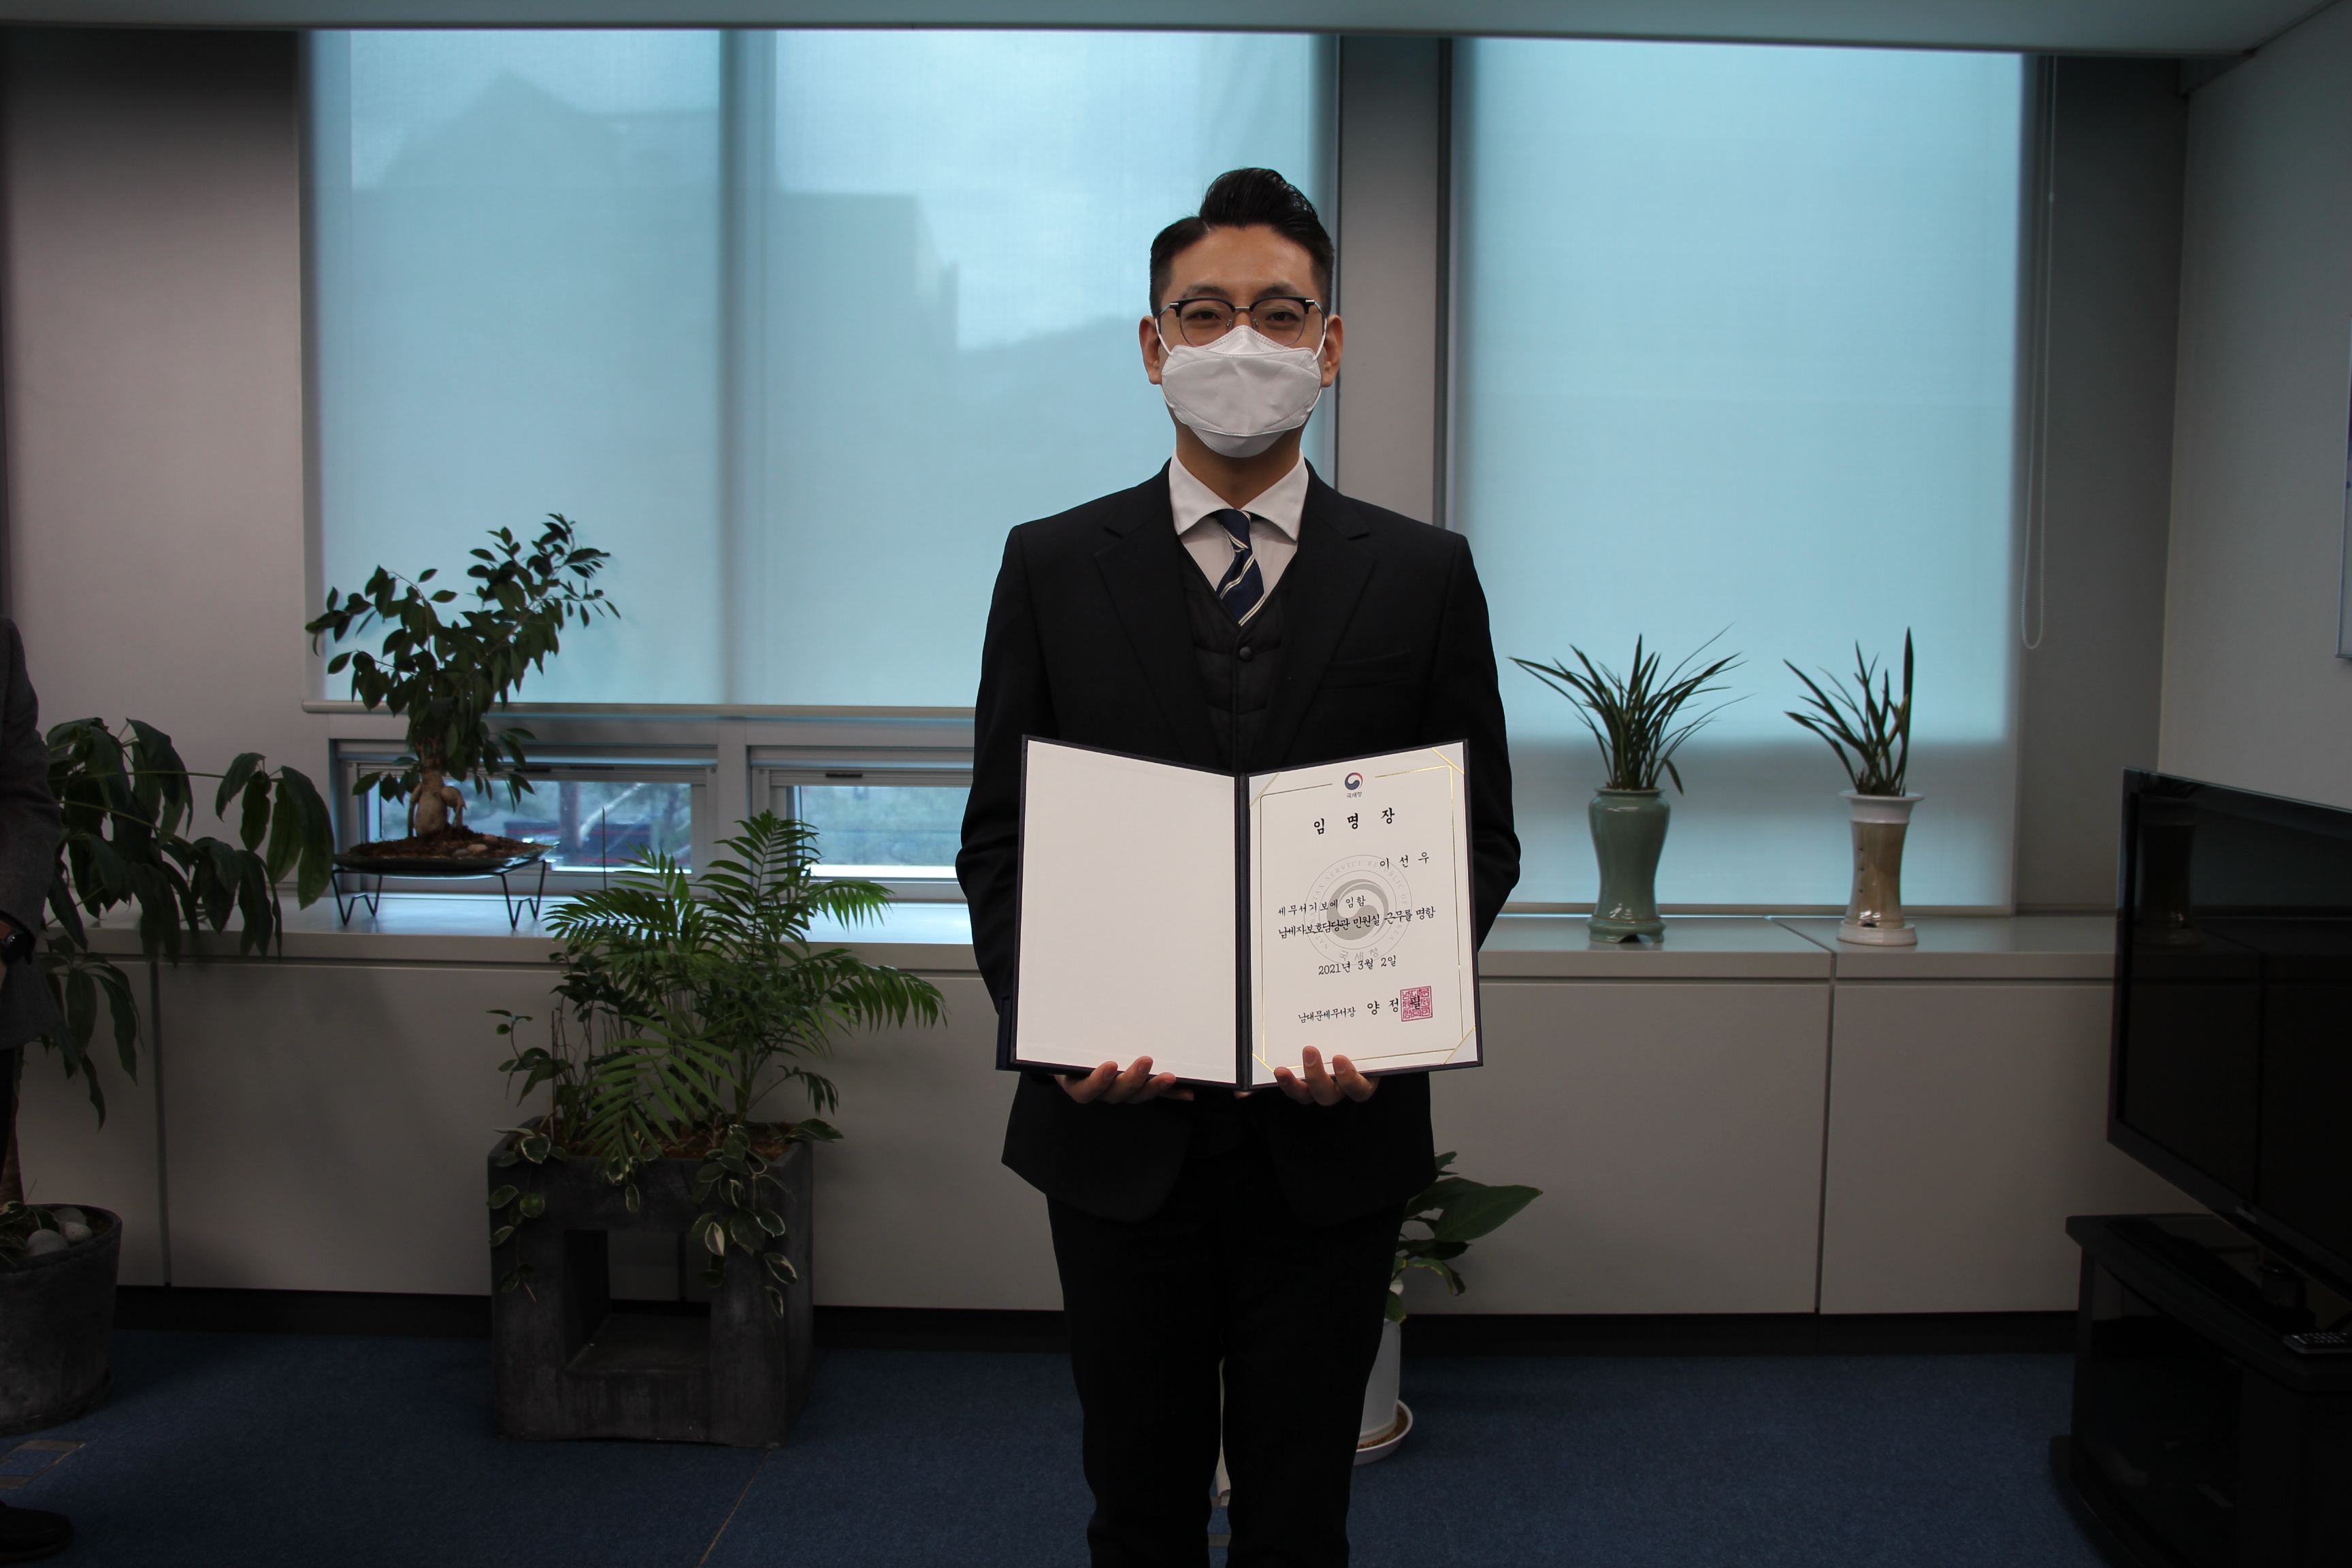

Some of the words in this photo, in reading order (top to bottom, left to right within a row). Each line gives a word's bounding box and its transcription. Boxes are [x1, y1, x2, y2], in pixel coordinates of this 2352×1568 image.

[1326, 860, 1362, 881] SERVICE
[1312, 883, 1324, 900] TAX
[1401, 894, 1407, 905] OF
[1278, 918, 1350, 939] 납세자보호담당관
[1353, 914, 1379, 928] 민원실
[1384, 909, 1413, 924] 근무를
[1416, 906, 1435, 920] 명함
[1388, 909, 1407, 941] OREA
[1318, 961, 1350, 975] 2021년
[1358, 958, 1373, 970] 3월
[1381, 955, 1396, 967] 2일
[1298, 1007, 1356, 1024] 남대문세무서장
